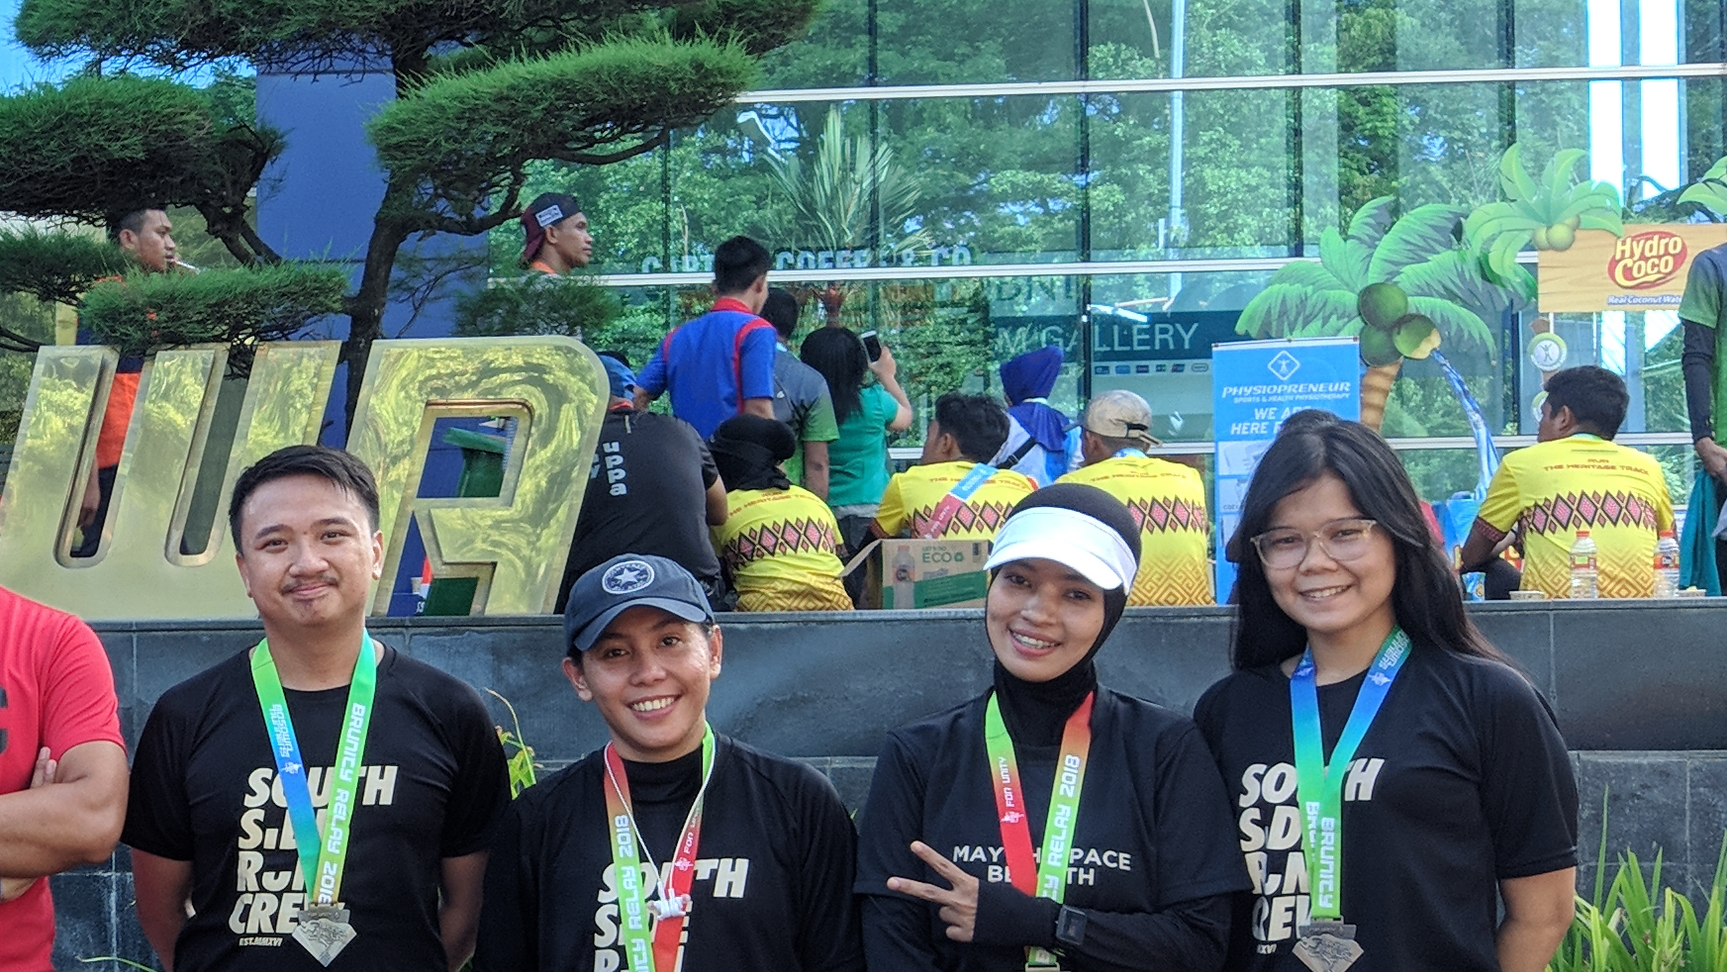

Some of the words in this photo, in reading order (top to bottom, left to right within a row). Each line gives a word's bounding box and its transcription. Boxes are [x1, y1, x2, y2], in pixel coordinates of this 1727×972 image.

[1615, 234, 1683, 262] Hydro
[1614, 255, 1674, 287] Coco
[1627, 293, 1662, 305] Coconut
[1221, 381, 1352, 399] PHYSIOPRENEUR
[1253, 407, 1278, 421] WE
[1230, 422, 1269, 436] HERE
[922, 551, 953, 564] ECO
[1059, 754, 1081, 798] 2018
[327, 788, 353, 855] RELAY
[1047, 804, 1072, 867] RELAY
[613, 814, 632, 859] 2018
[952, 845, 1005, 863] MAY
[1070, 848, 1133, 871] PACE
[620, 865, 643, 930] RELAY
